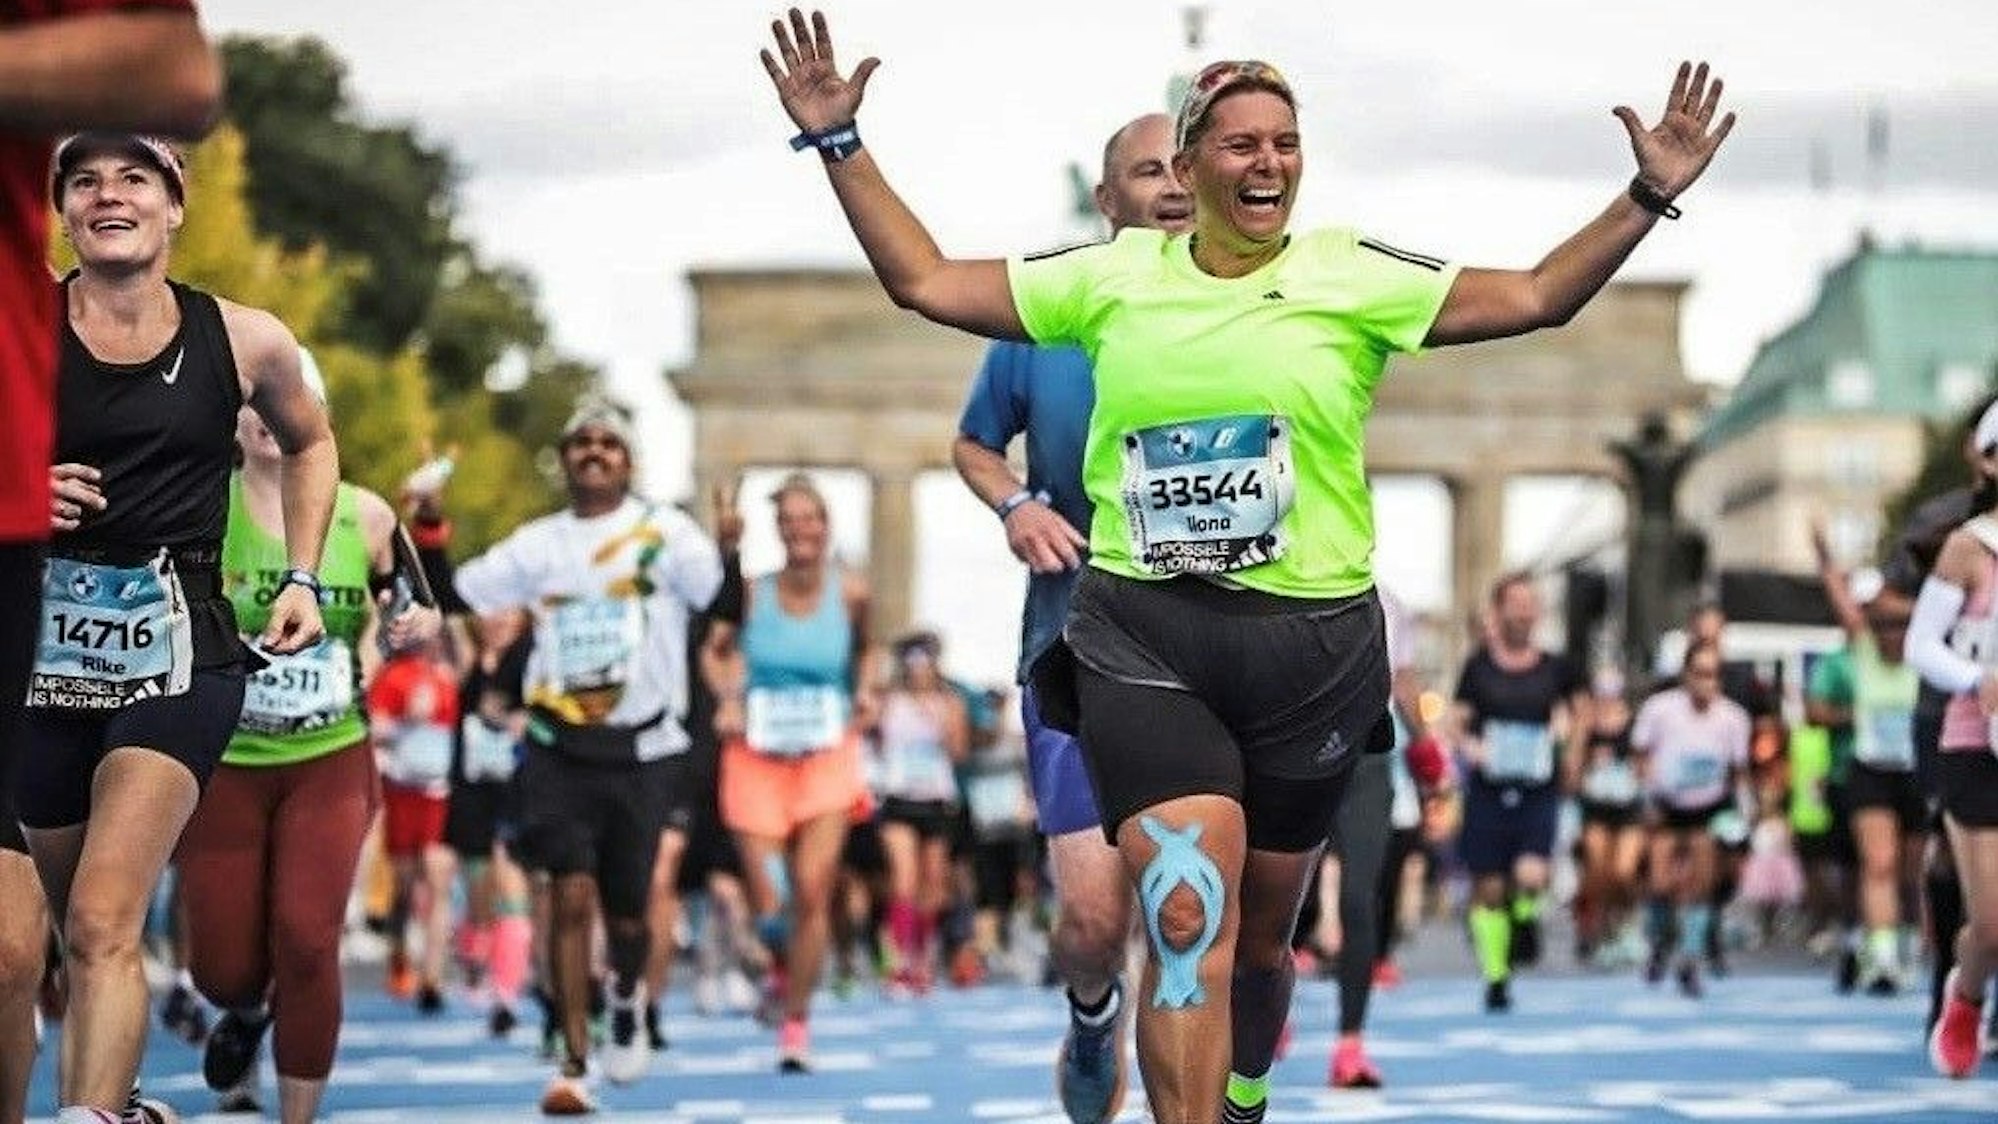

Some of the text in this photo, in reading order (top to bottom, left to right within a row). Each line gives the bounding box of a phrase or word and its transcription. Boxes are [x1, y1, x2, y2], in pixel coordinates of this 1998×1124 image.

[1149, 469, 1262, 510] 33544
[52, 613, 154, 651] 14716
[81, 655, 127, 675] Rike
[34, 674, 126, 697] IMPOSSIBLE
[49, 692, 122, 709] NOTHING
